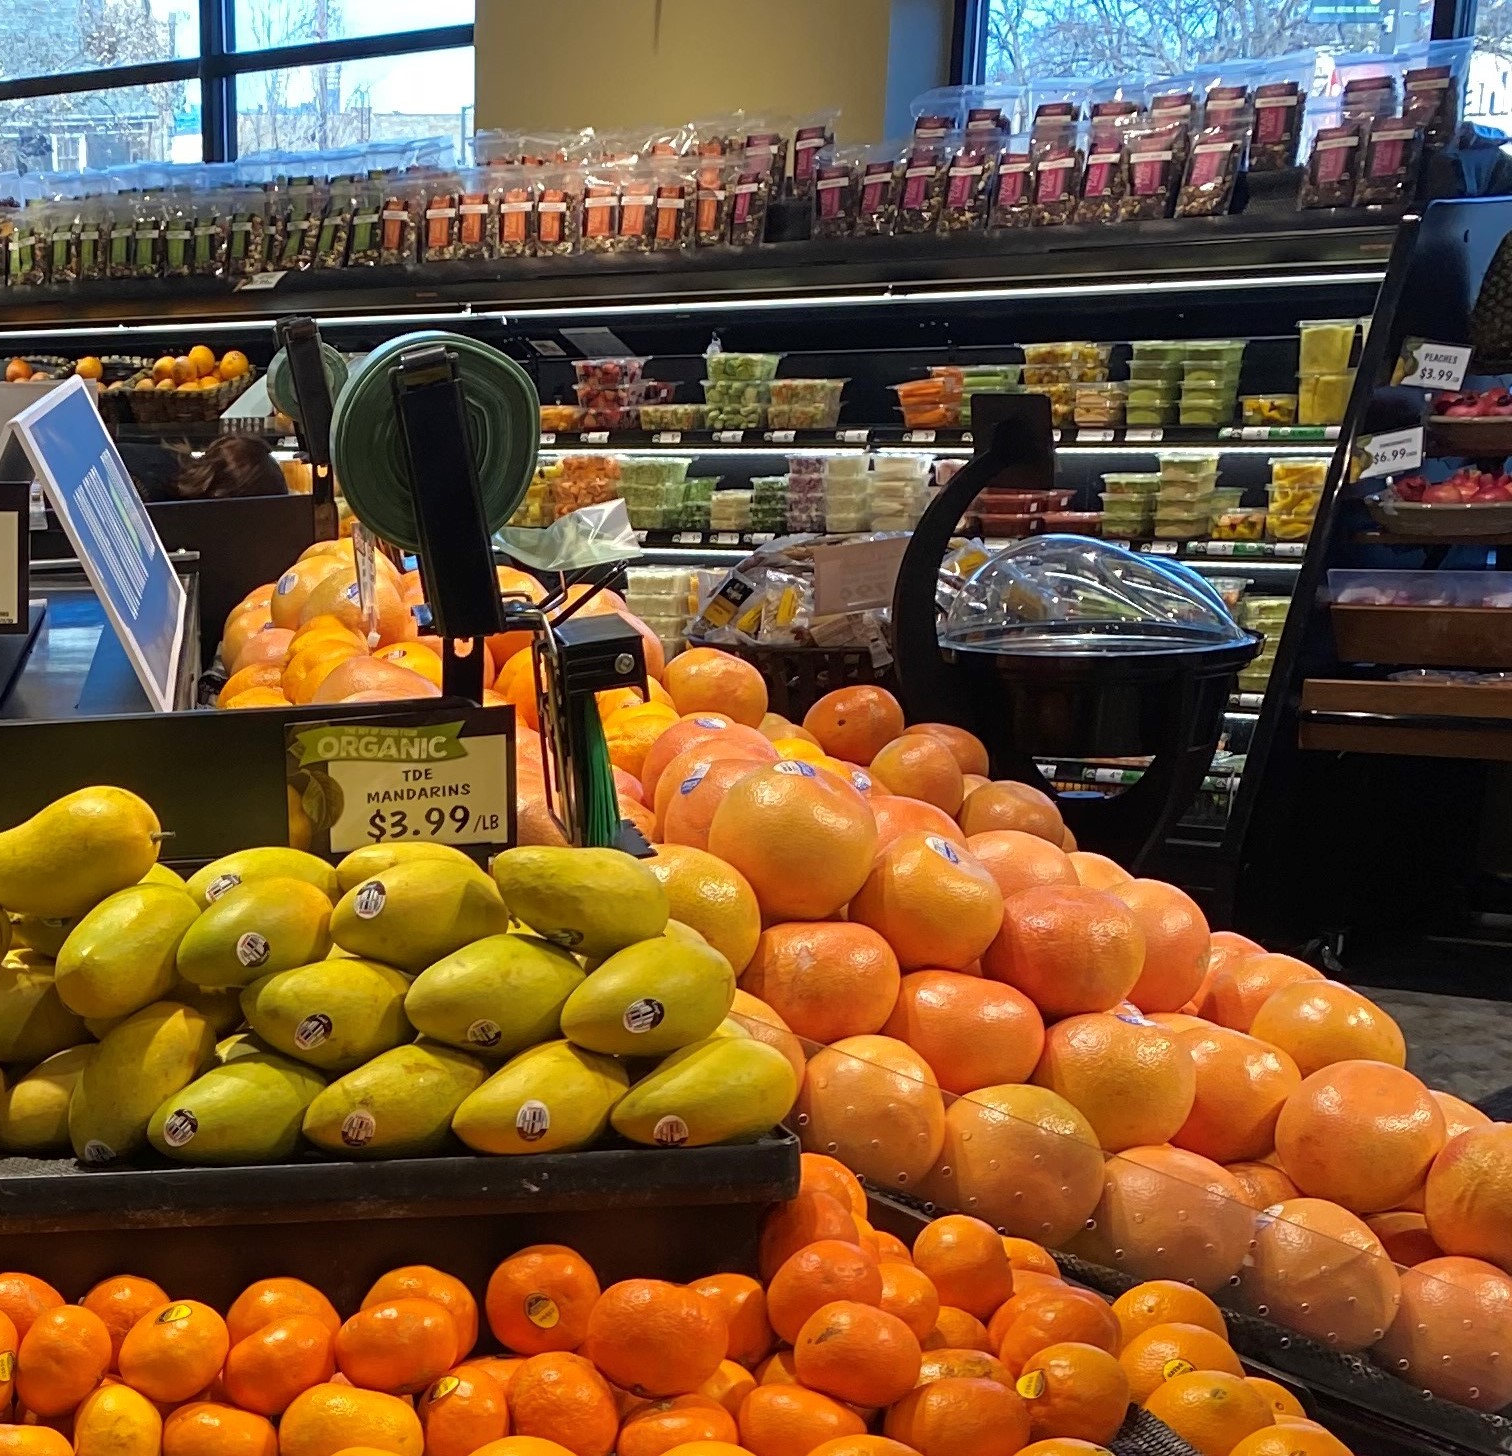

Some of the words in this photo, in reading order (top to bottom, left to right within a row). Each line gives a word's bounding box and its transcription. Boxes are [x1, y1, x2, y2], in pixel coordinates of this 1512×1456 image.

[1424, 353, 1458, 364] PEACHES
[1419, 367, 1453, 381] $3.99
[1373, 448, 1406, 464] $6.99
[317, 736, 448, 759] ORGANIC
[402, 768, 433, 782] TDE
[367, 783, 471, 804] MANDARINS
[367, 805, 470, 842] $3.99
